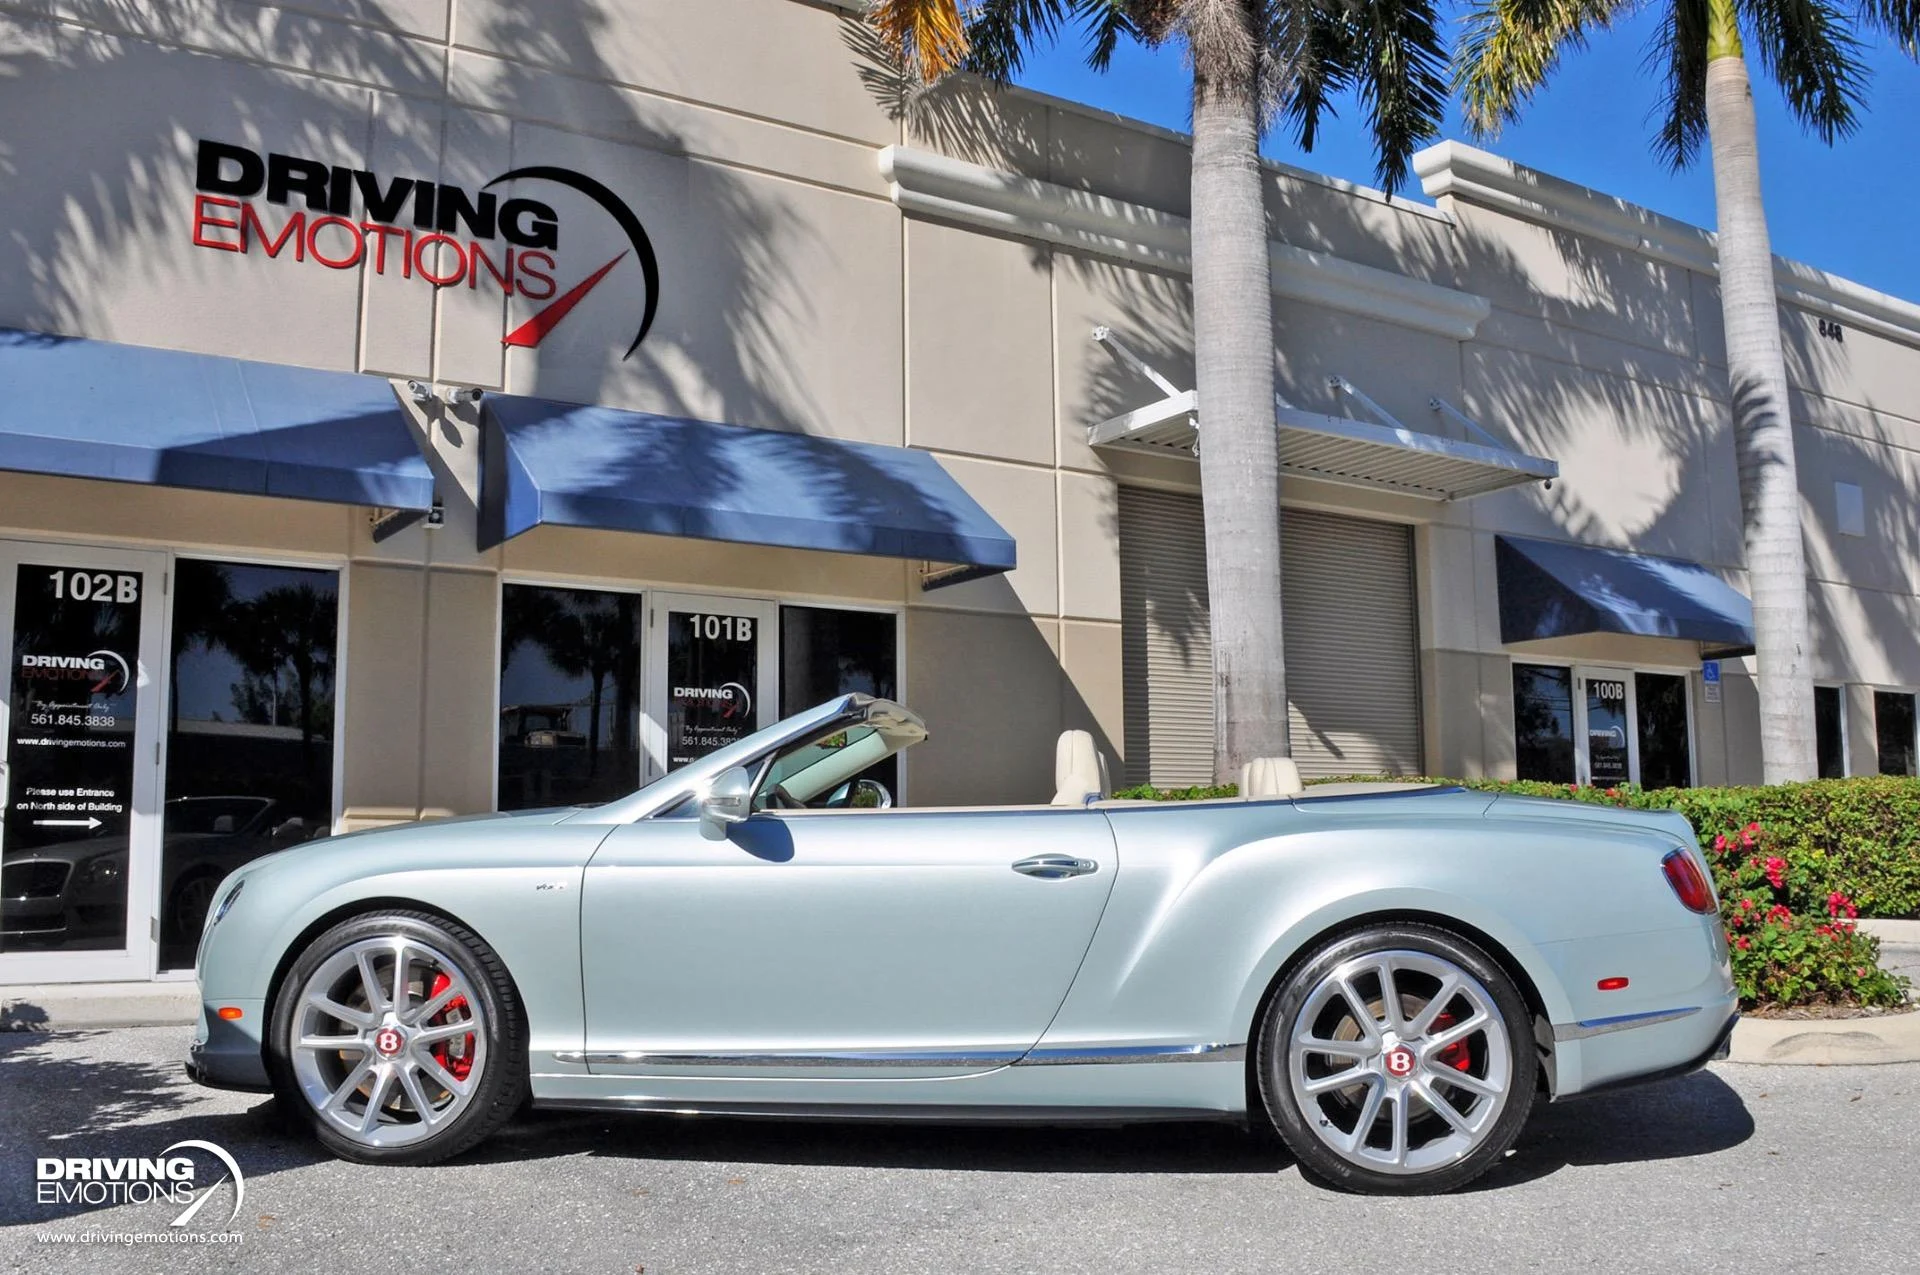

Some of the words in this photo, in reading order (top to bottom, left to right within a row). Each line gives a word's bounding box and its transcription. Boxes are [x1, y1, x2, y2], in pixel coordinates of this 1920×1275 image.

[195, 139, 559, 251] DRIVING
[193, 194, 557, 300] EMOTIONS
[1818, 318, 1844, 344] 848
[49, 570, 138, 604] 102B
[689, 614, 752, 642] 101B
[22, 654, 105, 670] DRIVING
[674, 687, 734, 700] DRIVING
[1593, 682, 1624, 700] 100B
[31, 712, 116, 727] 561.845.3838
[16, 737, 126, 748] www.drivingemotions.com
[26, 787, 57, 797] Please
[58, 788, 75, 797] use
[76, 787, 115, 798] Entrance
[16, 802, 29, 810] on
[30, 801, 56, 811] North
[57, 802, 76, 811] side
[77, 802, 87, 811] of
[87, 802, 123, 813] Building
